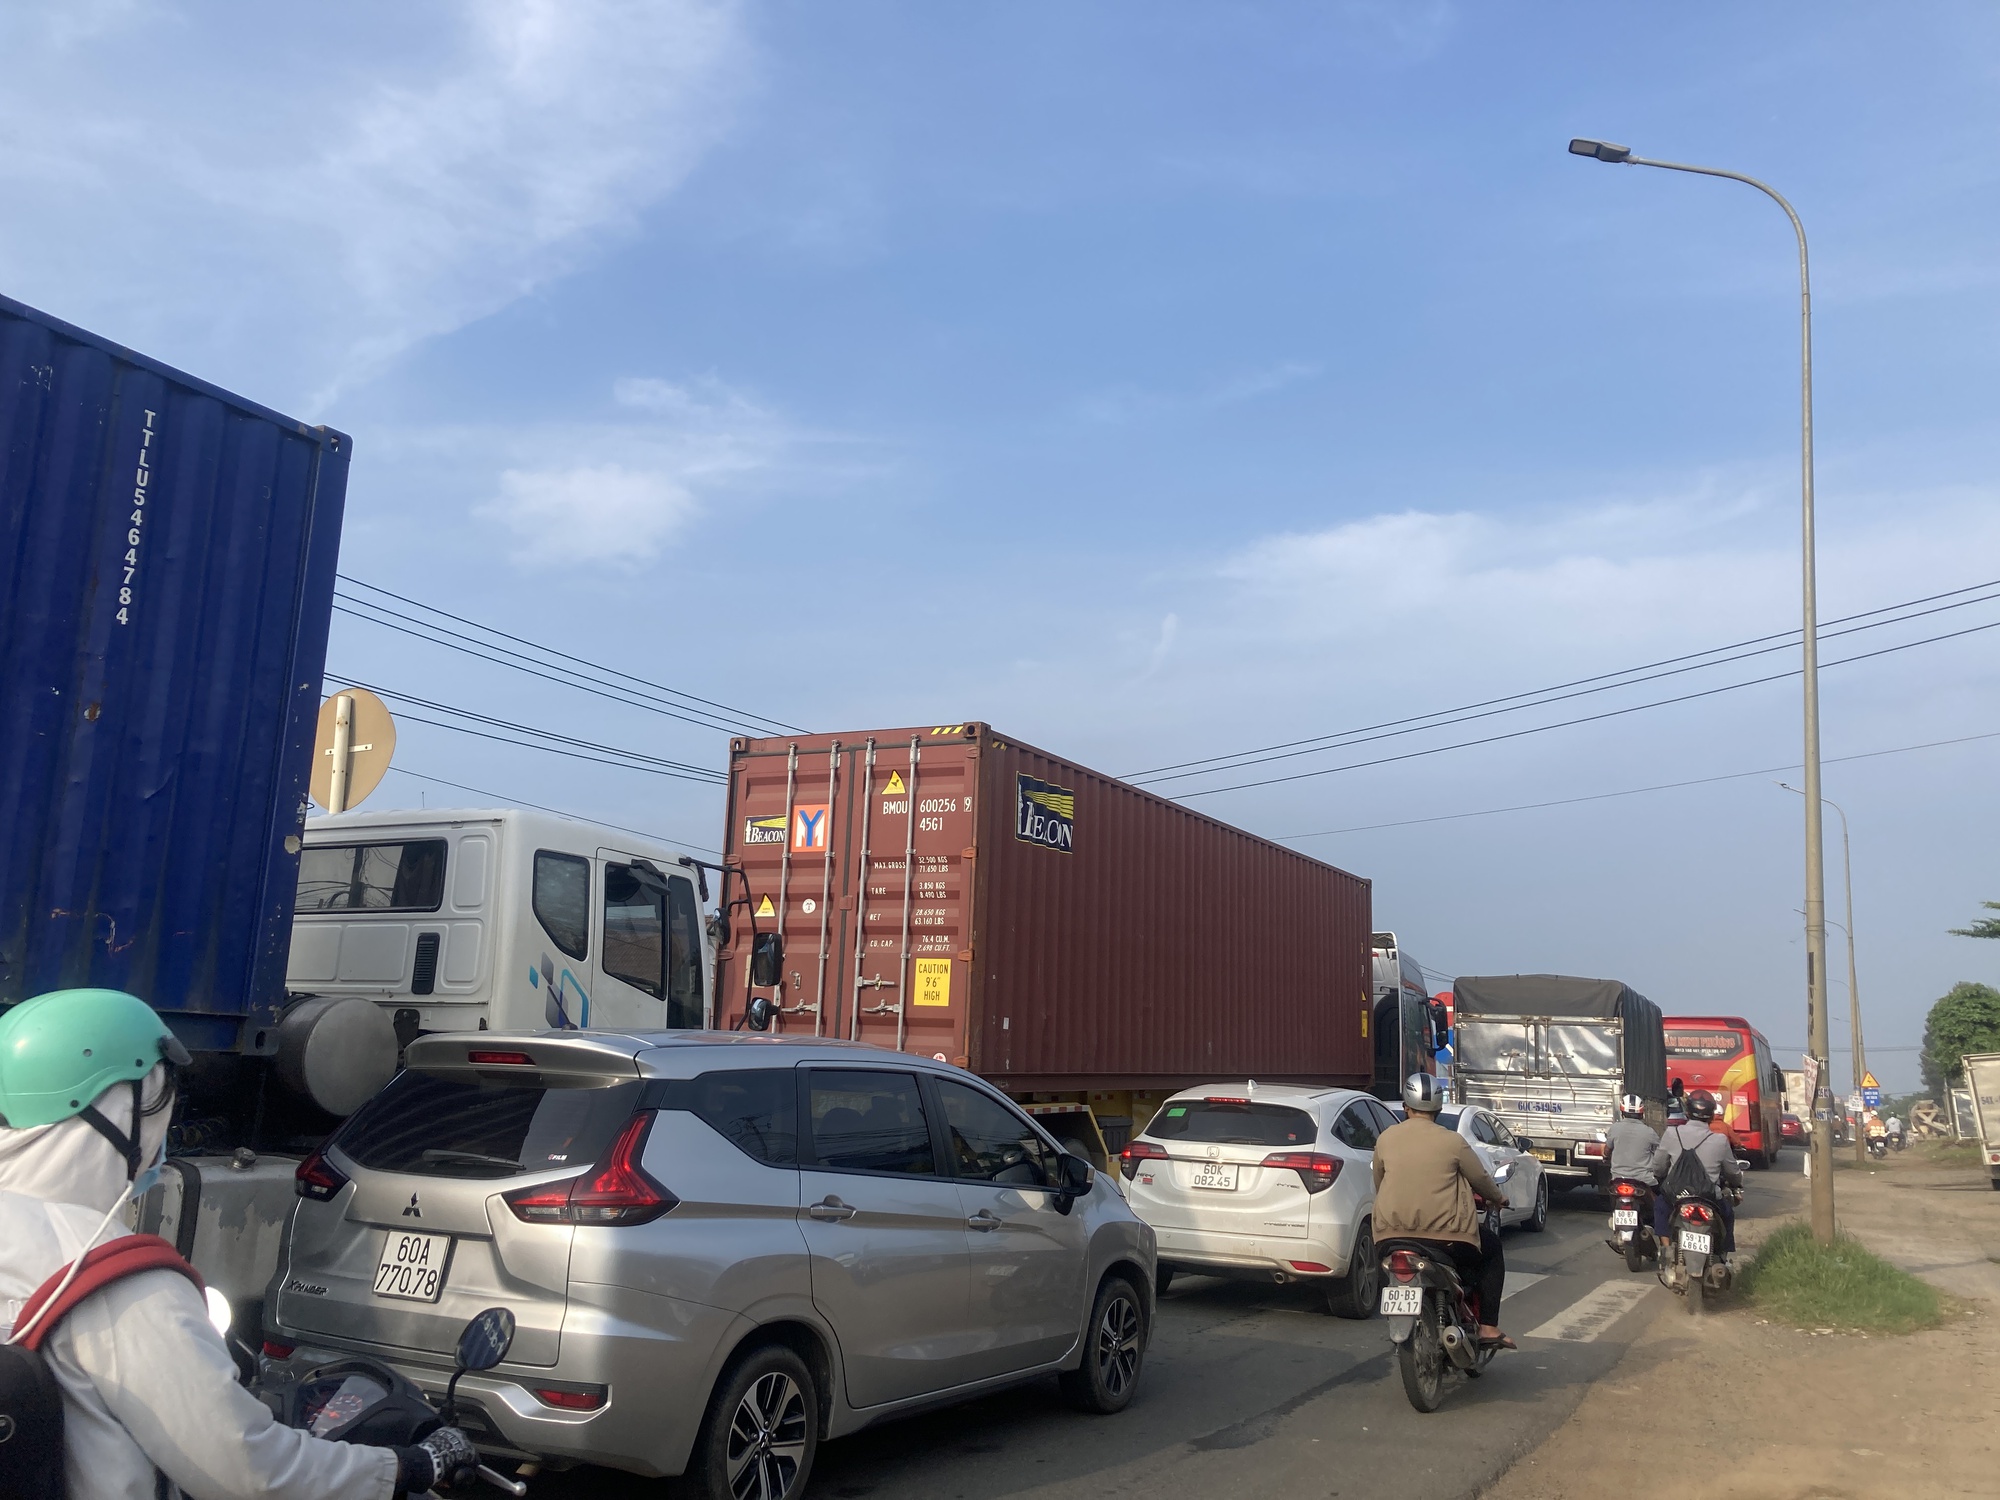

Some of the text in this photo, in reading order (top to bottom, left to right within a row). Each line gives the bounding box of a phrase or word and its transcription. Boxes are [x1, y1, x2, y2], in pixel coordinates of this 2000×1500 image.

[883, 797, 972, 815] BMOU 600256 9
[919, 817, 943, 831] 45G1
[750, 827, 786, 843] BEACON
[869, 913, 881, 921] NET
[918, 963, 949, 974] CAUTION
[923, 990, 940, 1001] HIGH
[1203, 1164, 1224, 1175] 60K
[1194, 1175, 1231, 1187] 082.45
[397, 1235, 431, 1265] 60A
[375, 1263, 438, 1296] 770.78
[1388, 1290, 1416, 1300] 60-B3
[1383, 1301, 1419, 1312] 074.17
